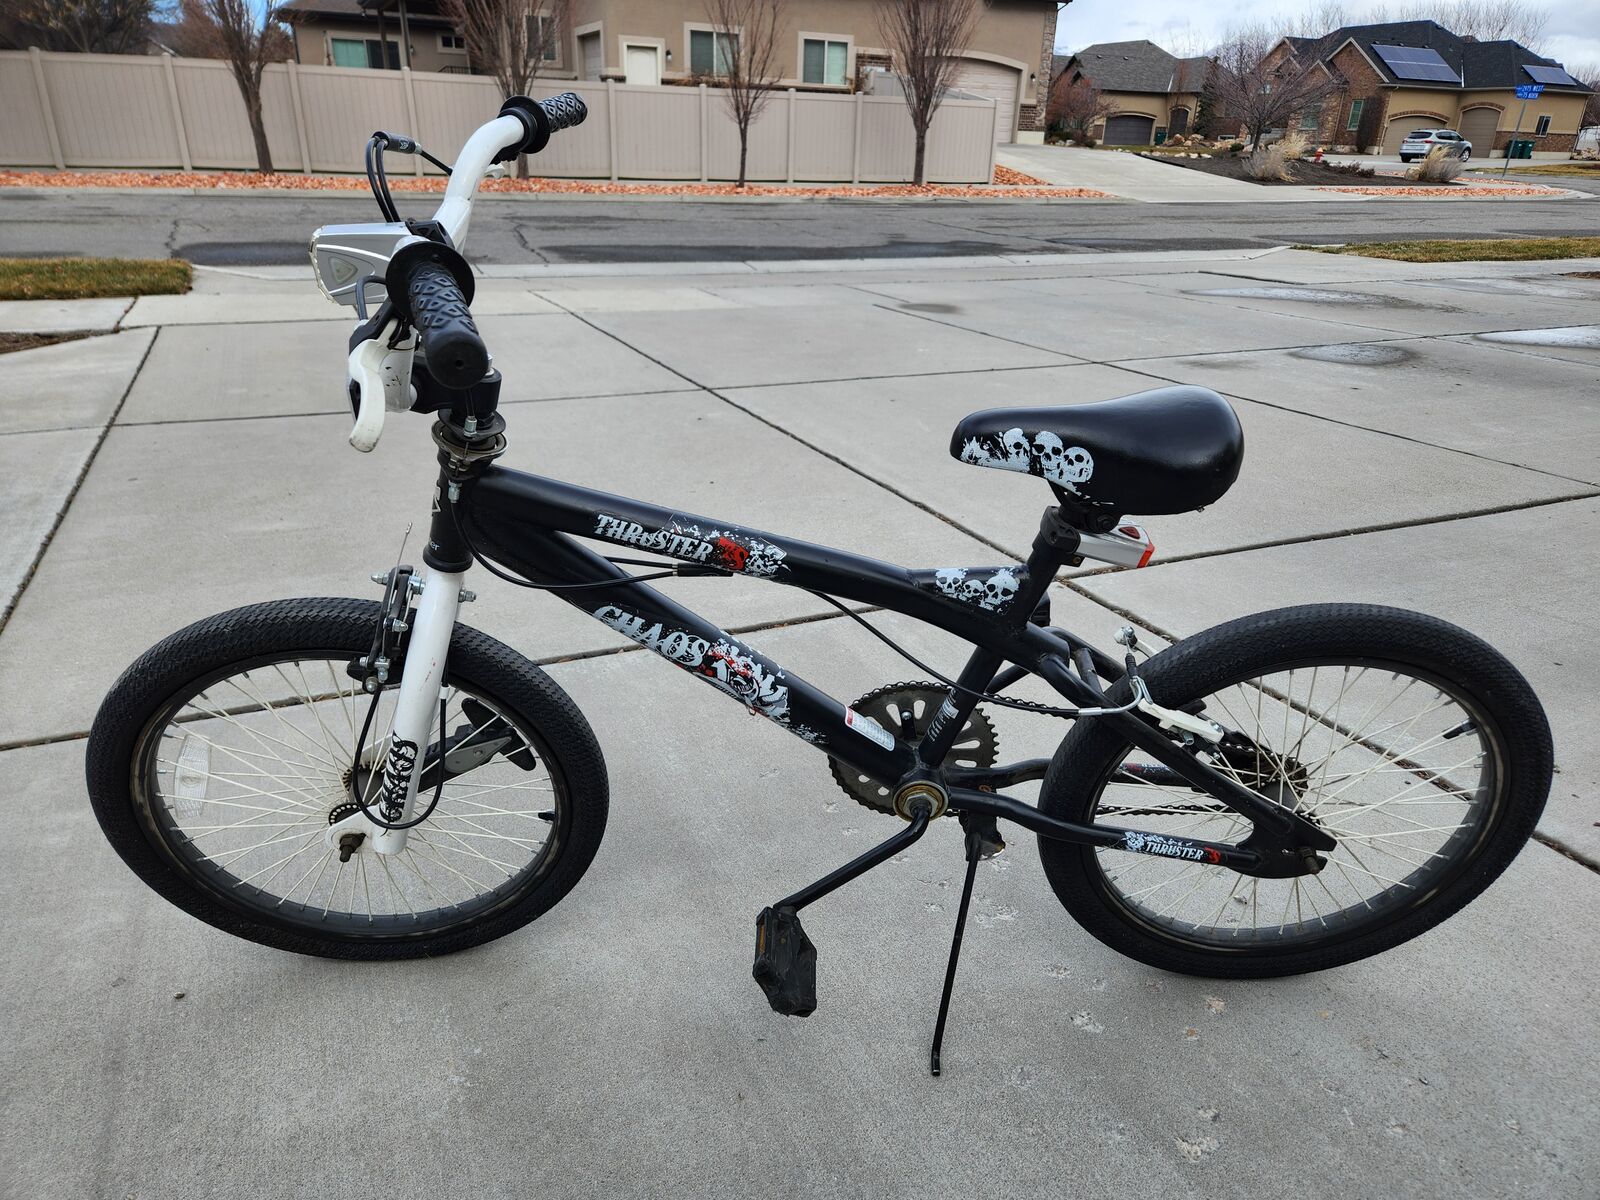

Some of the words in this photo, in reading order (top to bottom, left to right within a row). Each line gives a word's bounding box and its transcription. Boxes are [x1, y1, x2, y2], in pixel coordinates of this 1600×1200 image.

[596, 513, 714, 562] THRUSTER
[593, 604, 711, 667] CHAOS
[1144, 841, 1205, 861] THRUSTER
